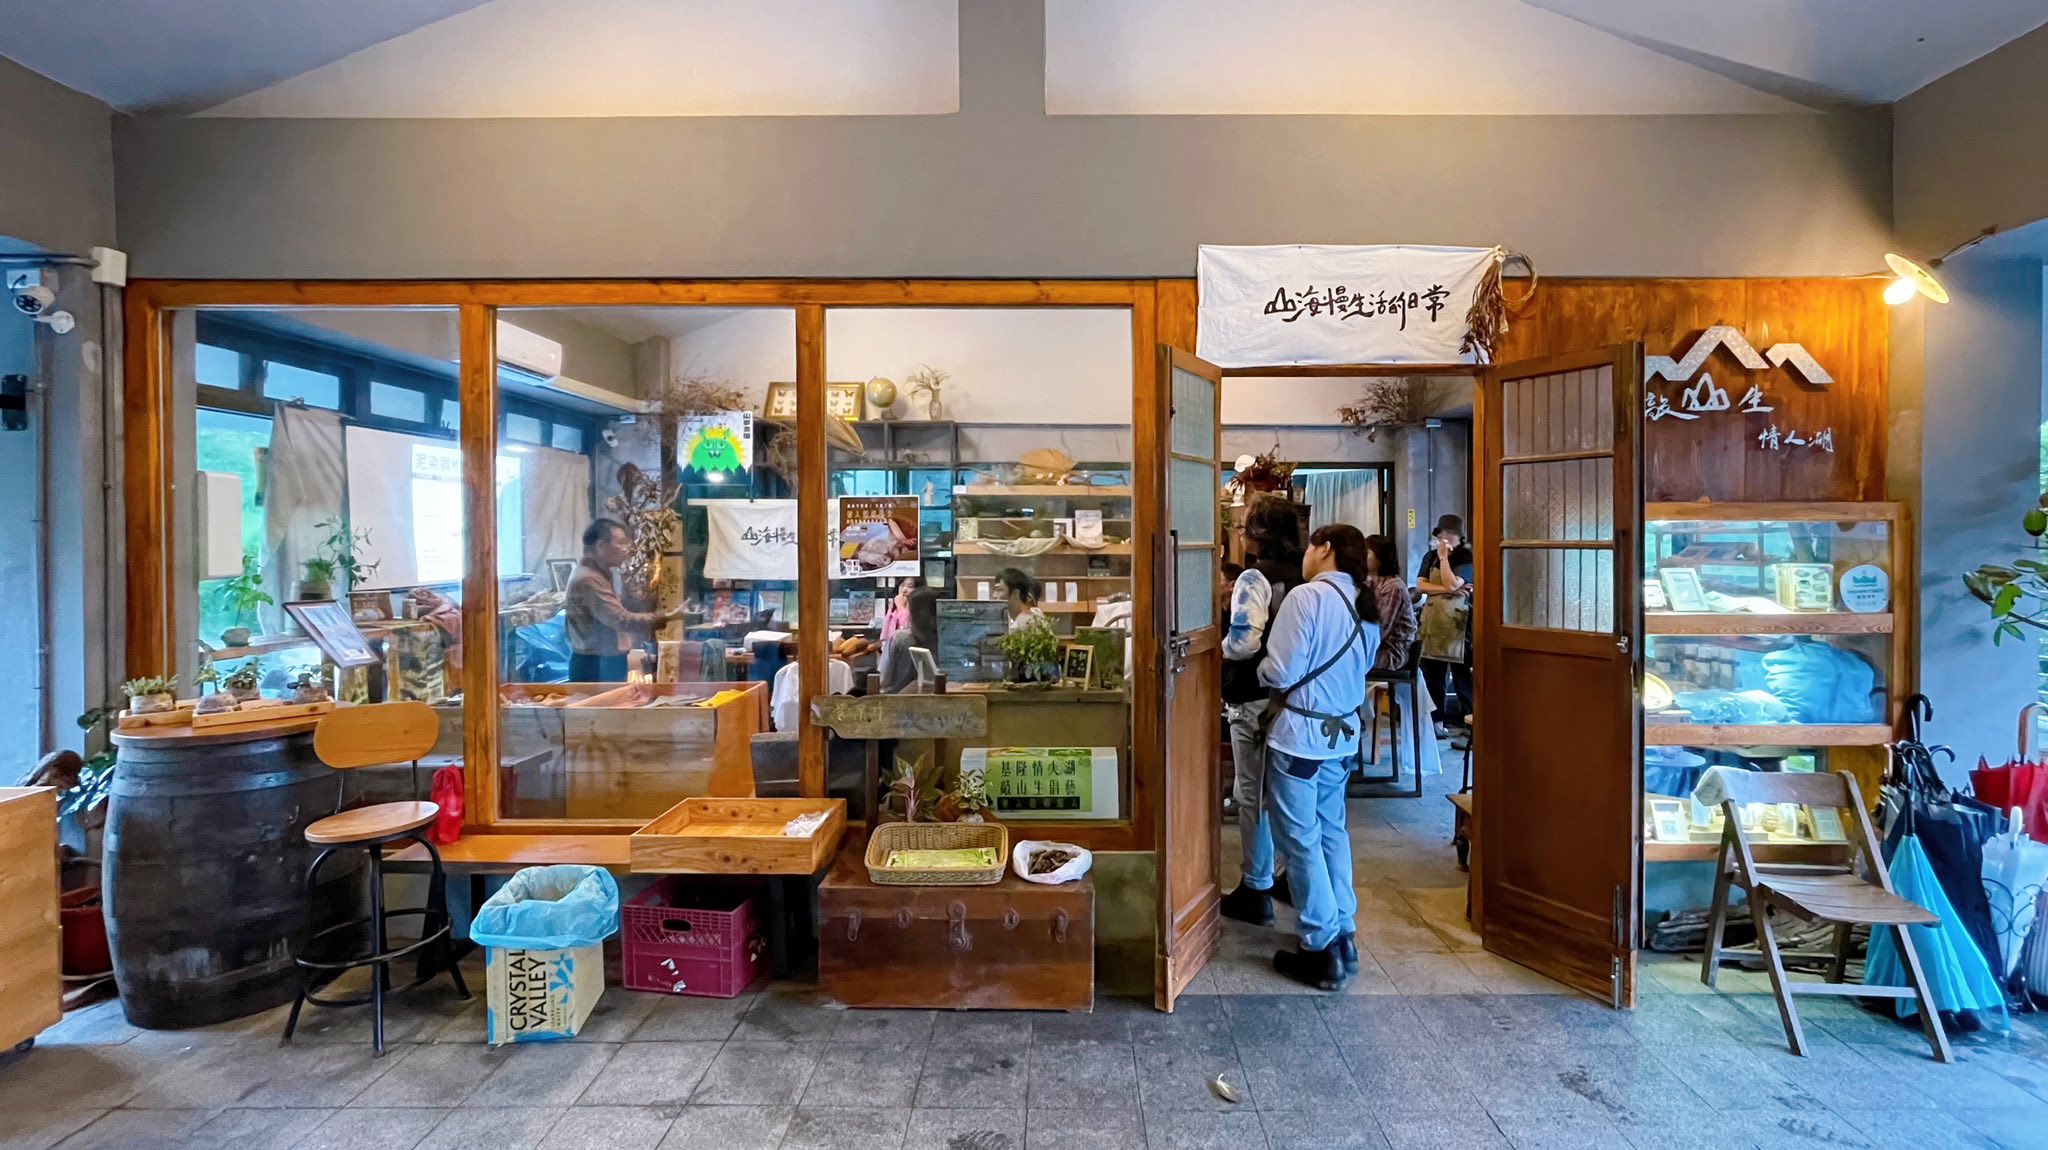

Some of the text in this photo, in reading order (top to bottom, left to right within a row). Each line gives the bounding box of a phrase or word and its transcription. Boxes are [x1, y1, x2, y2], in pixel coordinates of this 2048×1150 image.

[1264, 284, 1451, 332] 山海慢生活的日常
[1758, 423, 1835, 453] 情人湖
[1000, 760, 1076, 777] 基隆情人湖
[509, 949, 527, 1030] CRYSTAL
[528, 958, 547, 1029] VALLEY
